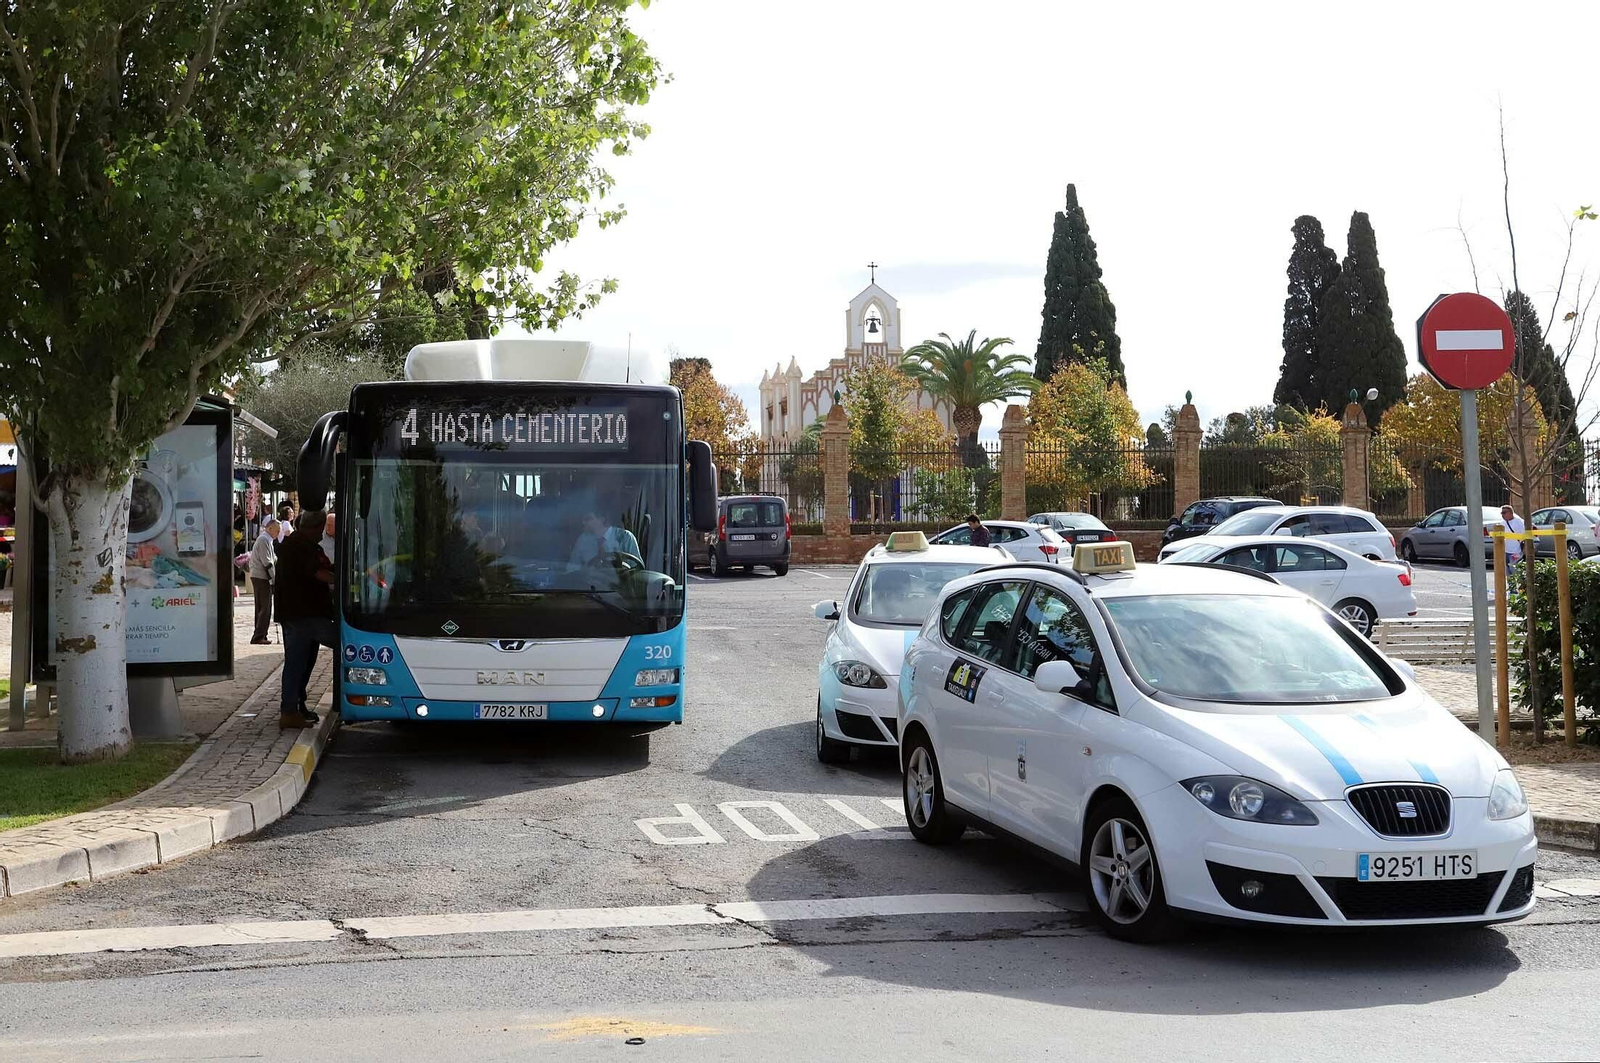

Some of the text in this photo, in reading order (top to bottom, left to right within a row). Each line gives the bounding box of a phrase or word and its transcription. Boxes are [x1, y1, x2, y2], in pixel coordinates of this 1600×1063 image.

[401, 408, 627, 446] 4 HASTA CEMENTERIO
[1095, 547, 1120, 565] TAXI
[166, 598, 195, 607] ARIEL
[145, 624, 176, 632] SENCILLA
[644, 645, 672, 660] 320
[477, 671, 546, 686] MAN
[483, 705, 543, 718] 7782 KRJ
[1374, 856, 1423, 878] 9251
[1434, 855, 1472, 876] HTS
